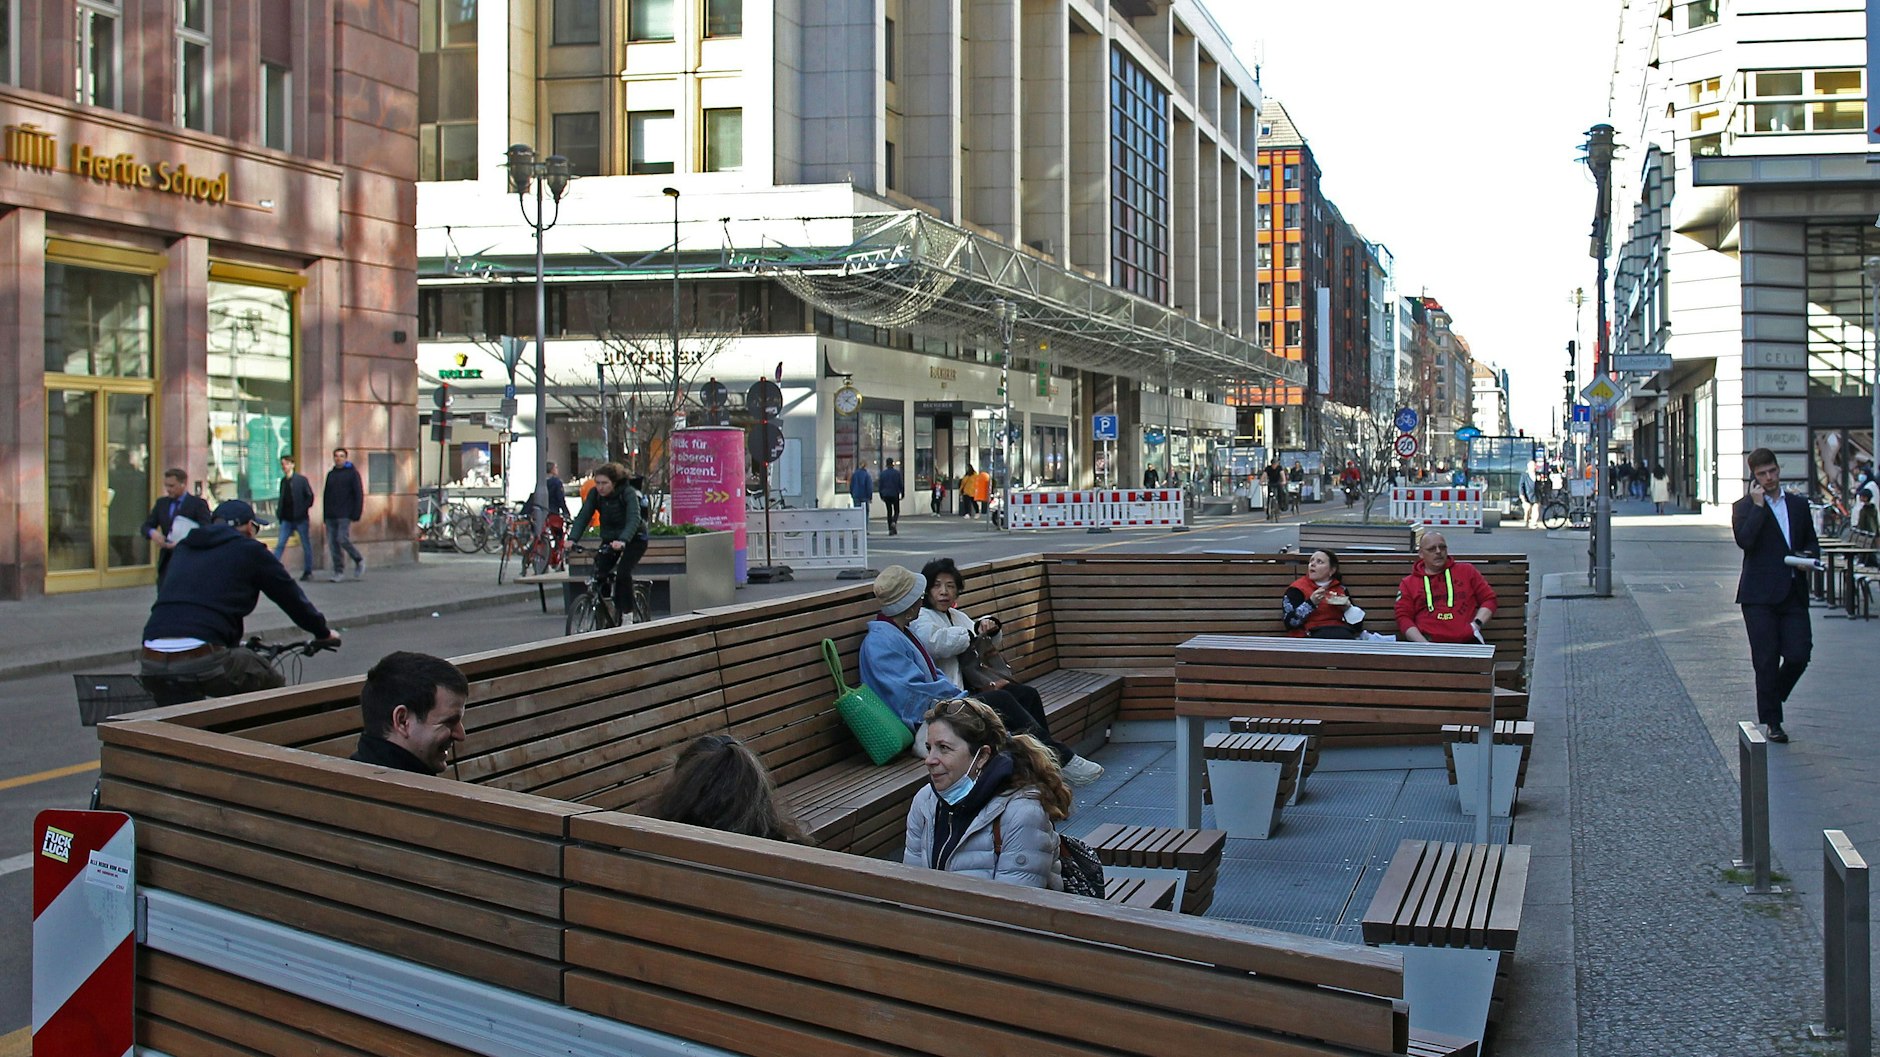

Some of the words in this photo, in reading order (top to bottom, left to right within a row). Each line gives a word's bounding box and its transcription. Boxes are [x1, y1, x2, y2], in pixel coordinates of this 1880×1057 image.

[71, 143, 150, 188] Hertie
[157, 160, 229, 201] School
[438, 369, 483, 379] ROLEX
[1101, 419, 1110, 432] P
[691, 438, 707, 450] für
[677, 452, 714, 463] oberen
[675, 465, 717, 477] Prozent.
[45, 830, 72, 849] FUCK
[43, 840, 69, 859] LUCA
